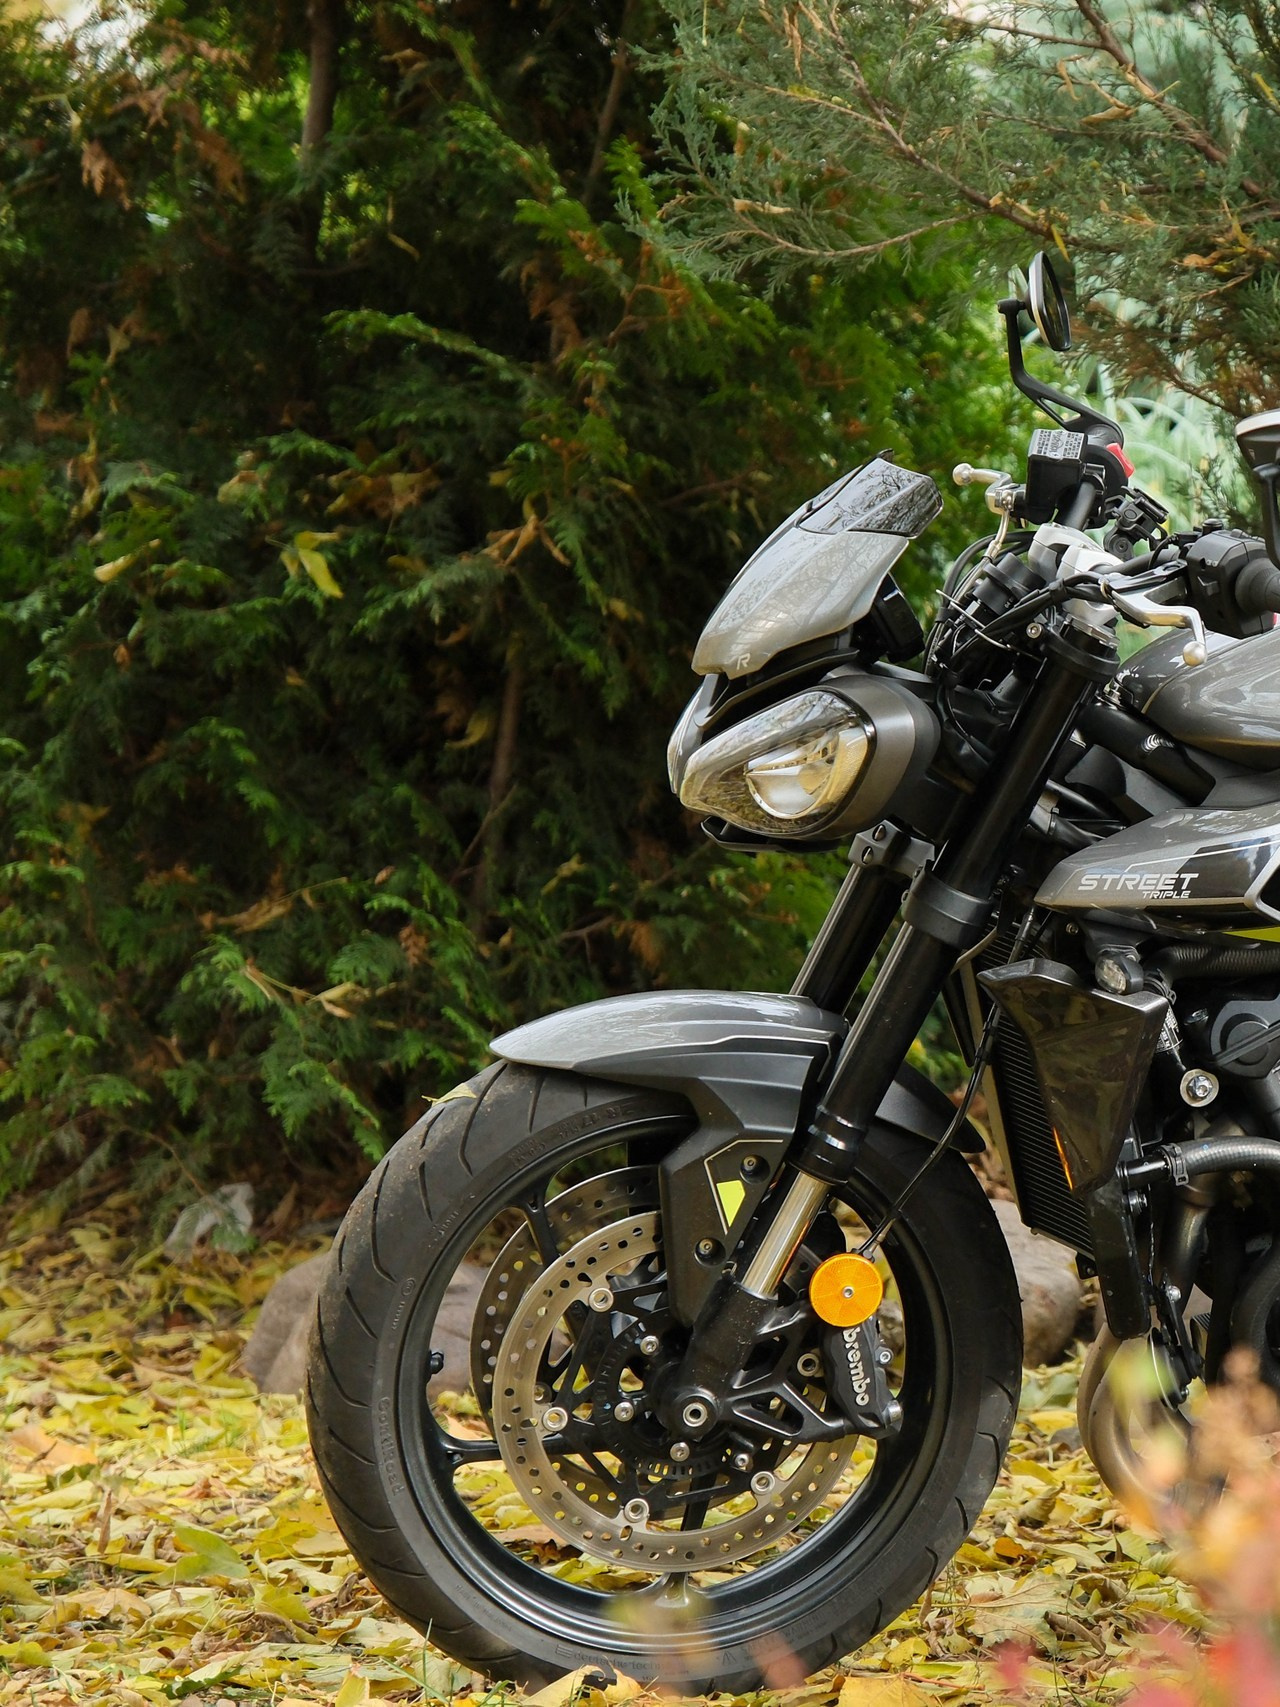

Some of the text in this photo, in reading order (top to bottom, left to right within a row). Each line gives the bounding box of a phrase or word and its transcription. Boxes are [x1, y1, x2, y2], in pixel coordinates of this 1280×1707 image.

[735, 652, 751, 670] R
[1078, 873, 1199, 891] STREET
[1142, 890, 1191, 899] TRIPLE
[842, 1327, 871, 1406] brembo
